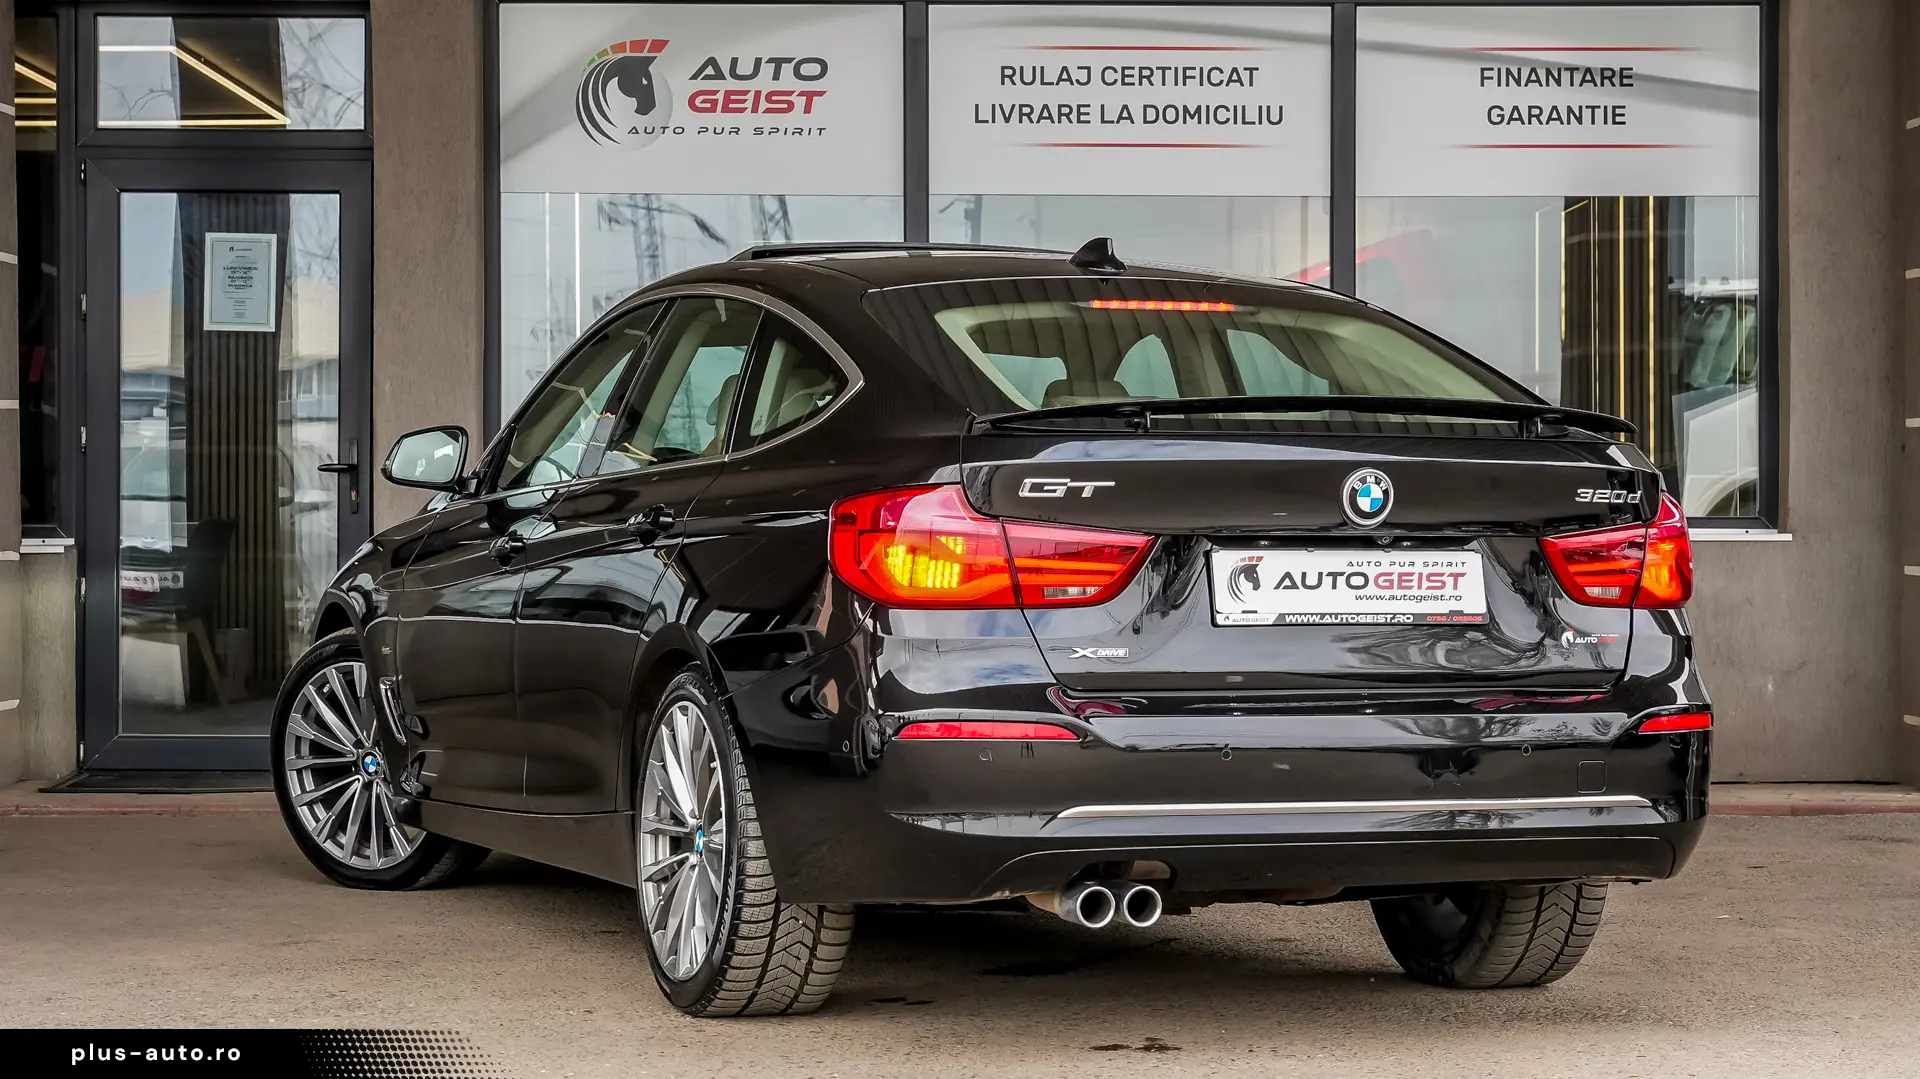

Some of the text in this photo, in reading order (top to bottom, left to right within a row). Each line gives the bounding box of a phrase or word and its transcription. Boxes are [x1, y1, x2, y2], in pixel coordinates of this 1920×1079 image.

[688, 56, 829, 82] AUTO
[1000, 65, 1260, 87] RULAJ CERTIFICAT
[1480, 66, 1634, 88] FINANTARE
[687, 89, 828, 115] GEIST
[974, 103, 1284, 126] LIVRARE LA DOMICILIU
[1487, 104, 1627, 126] GARANTIE
[626, 125, 828, 137] AUTO PUR SPIRIT
[1018, 478, 1116, 498] GT
[1575, 488, 1643, 504] 320d
[1346, 560, 1382, 568] AUTO
[1388, 560, 1416, 568] PUR
[1355, 592, 1463, 604] www.autogeist.ro
[1284, 614, 1414, 624] WWW.AUTOGEIST.RO
